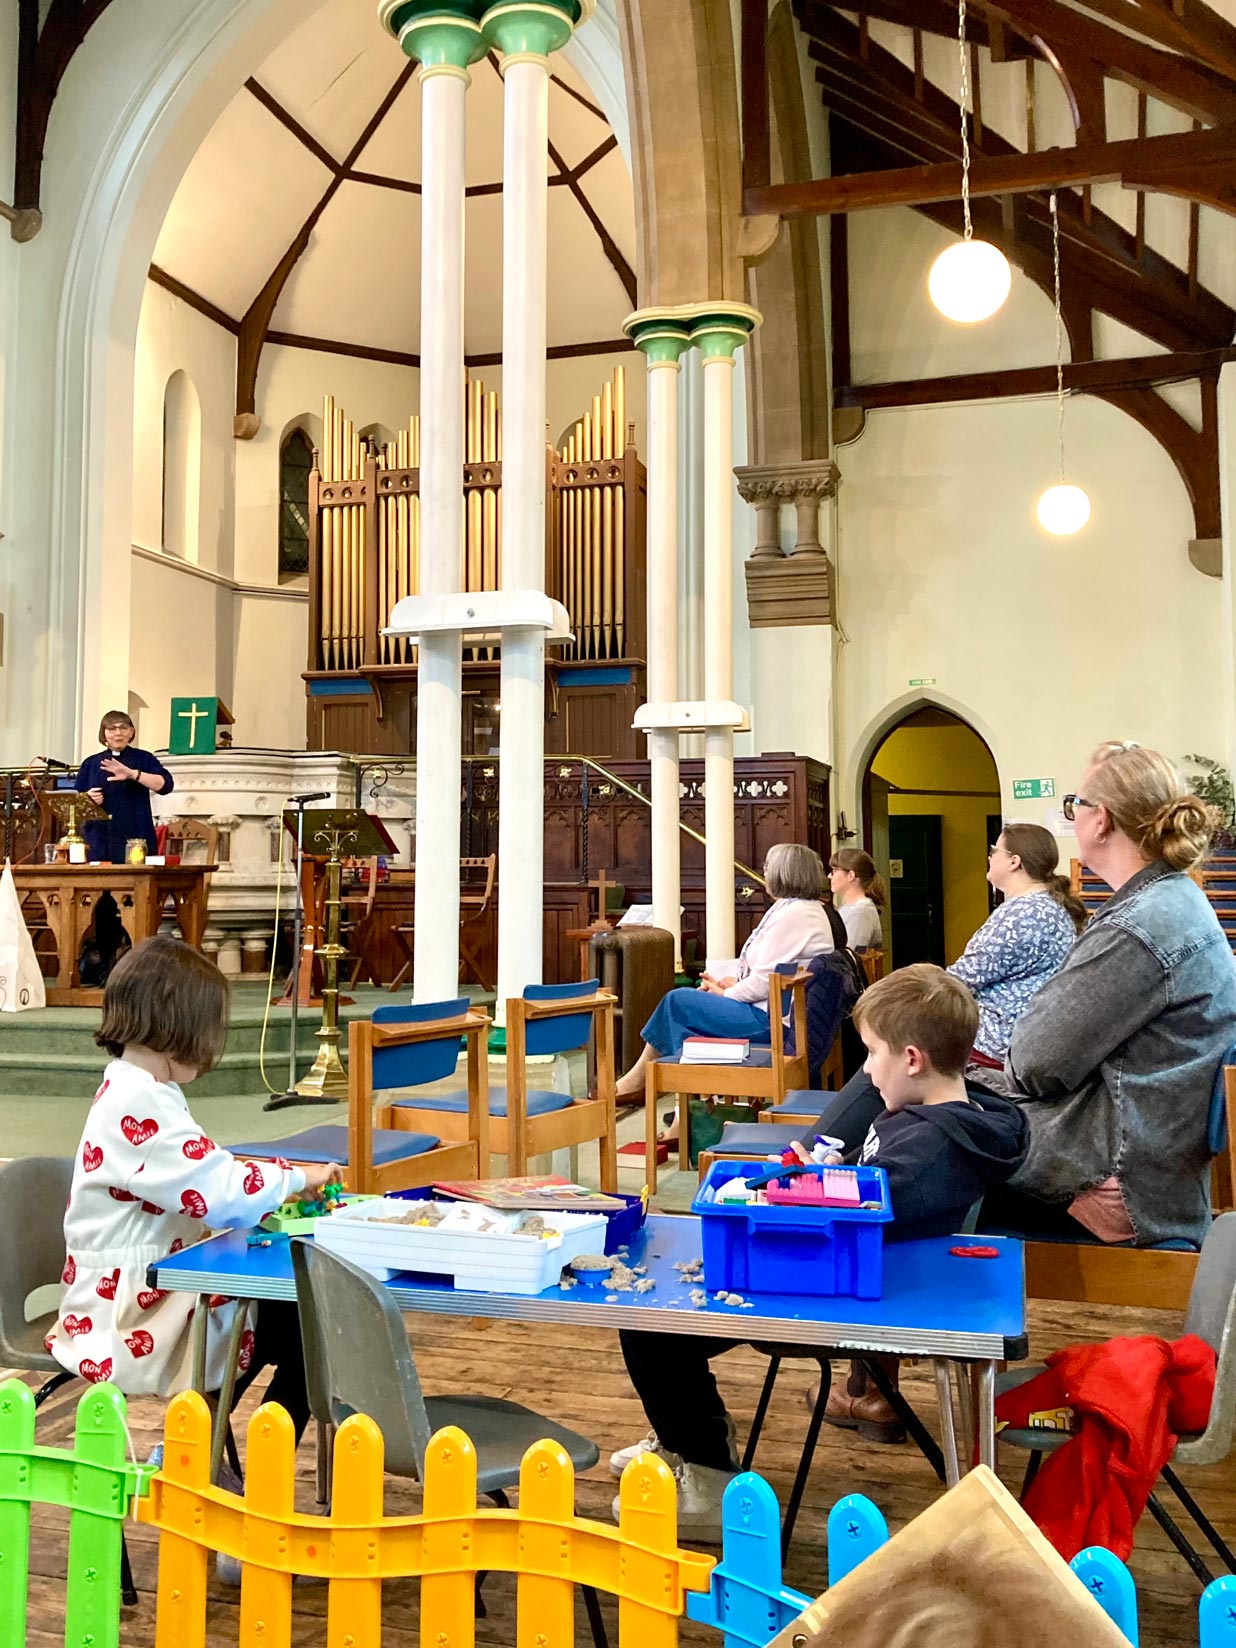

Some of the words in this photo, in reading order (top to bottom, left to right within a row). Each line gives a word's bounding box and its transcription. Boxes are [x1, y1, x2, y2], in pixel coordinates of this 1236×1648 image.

[1014, 781, 1032, 789] Fire
[1015, 789, 1033, 797] exit
[123, 1118, 144, 1133] MON
[131, 1128, 155, 1144] AMIE
[185, 1142, 206, 1157] MON
[128, 1336, 142, 1349] ON
[81, 1362, 102, 1374] MON
